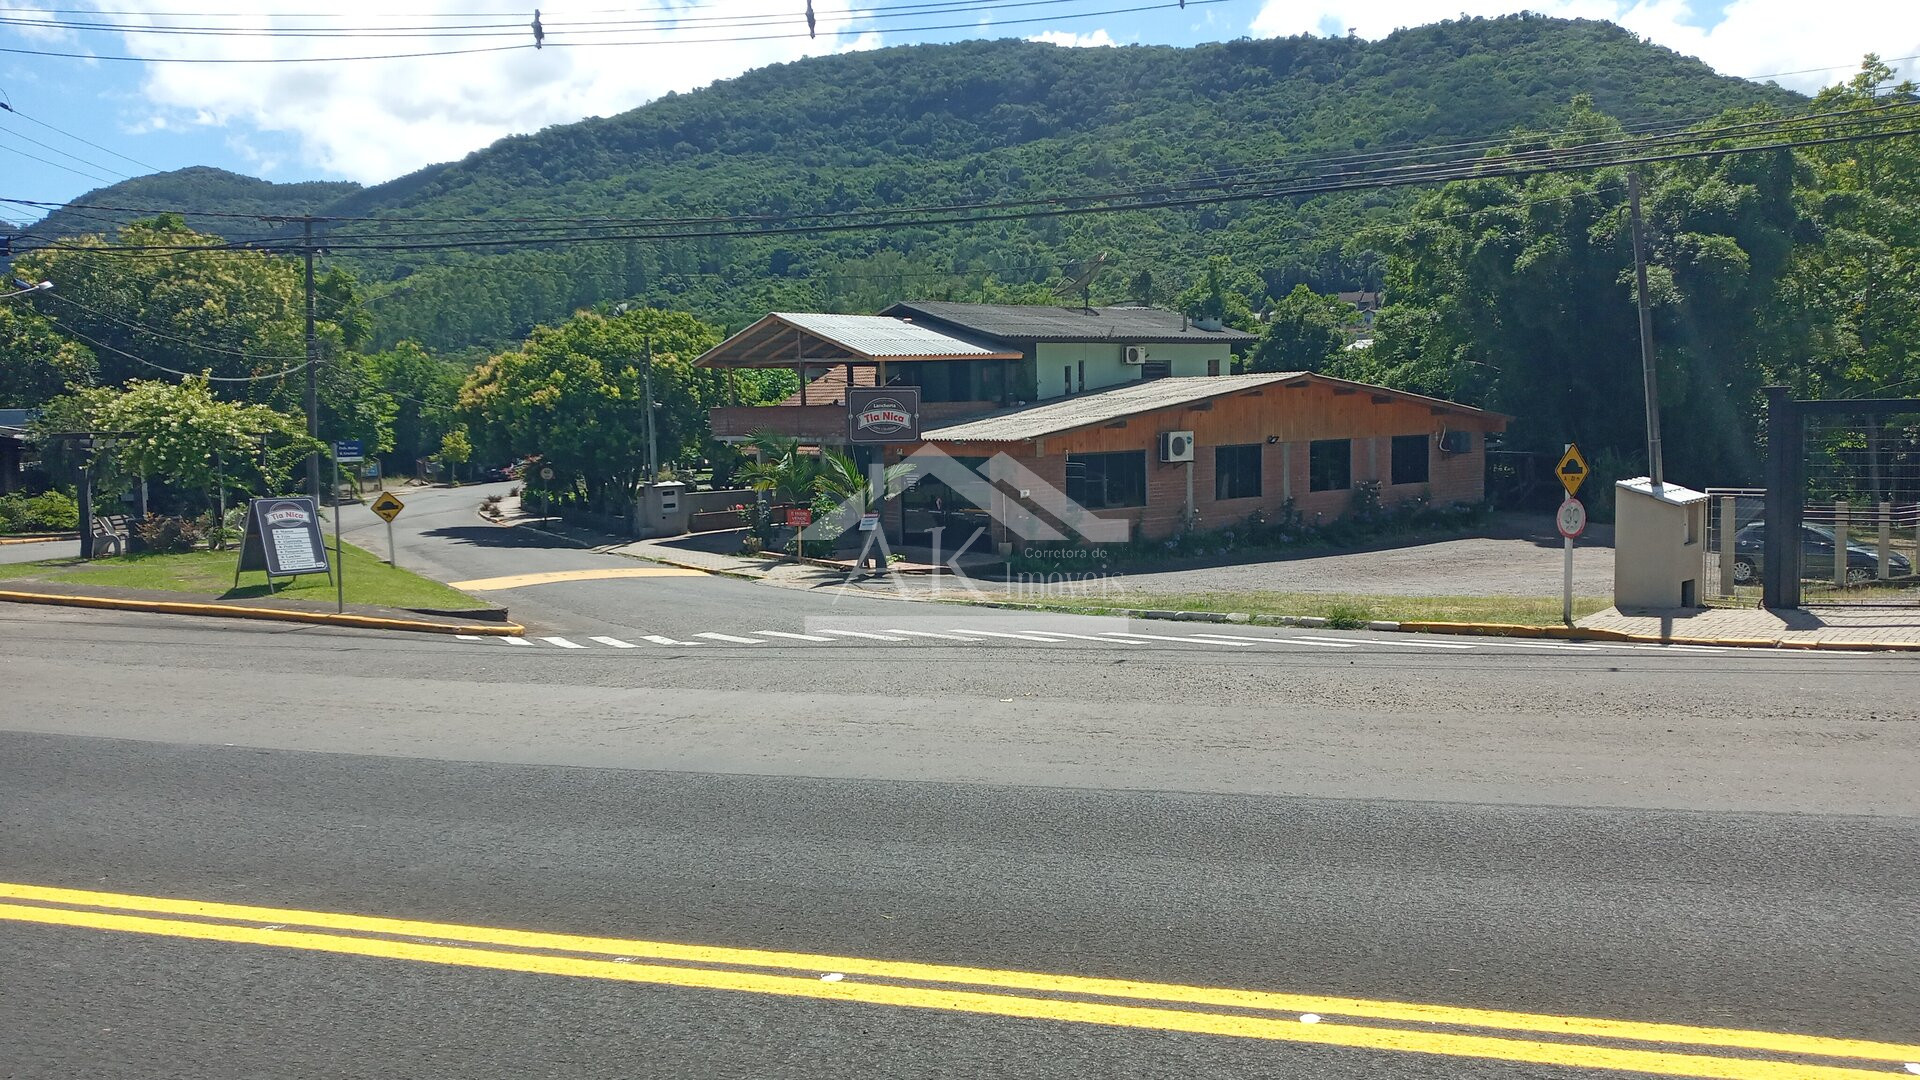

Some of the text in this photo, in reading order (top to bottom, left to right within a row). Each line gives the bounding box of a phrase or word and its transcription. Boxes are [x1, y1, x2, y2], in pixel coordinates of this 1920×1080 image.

[864, 411, 905, 423] Tia Nica
[271, 511, 304, 521] Tia Nica
